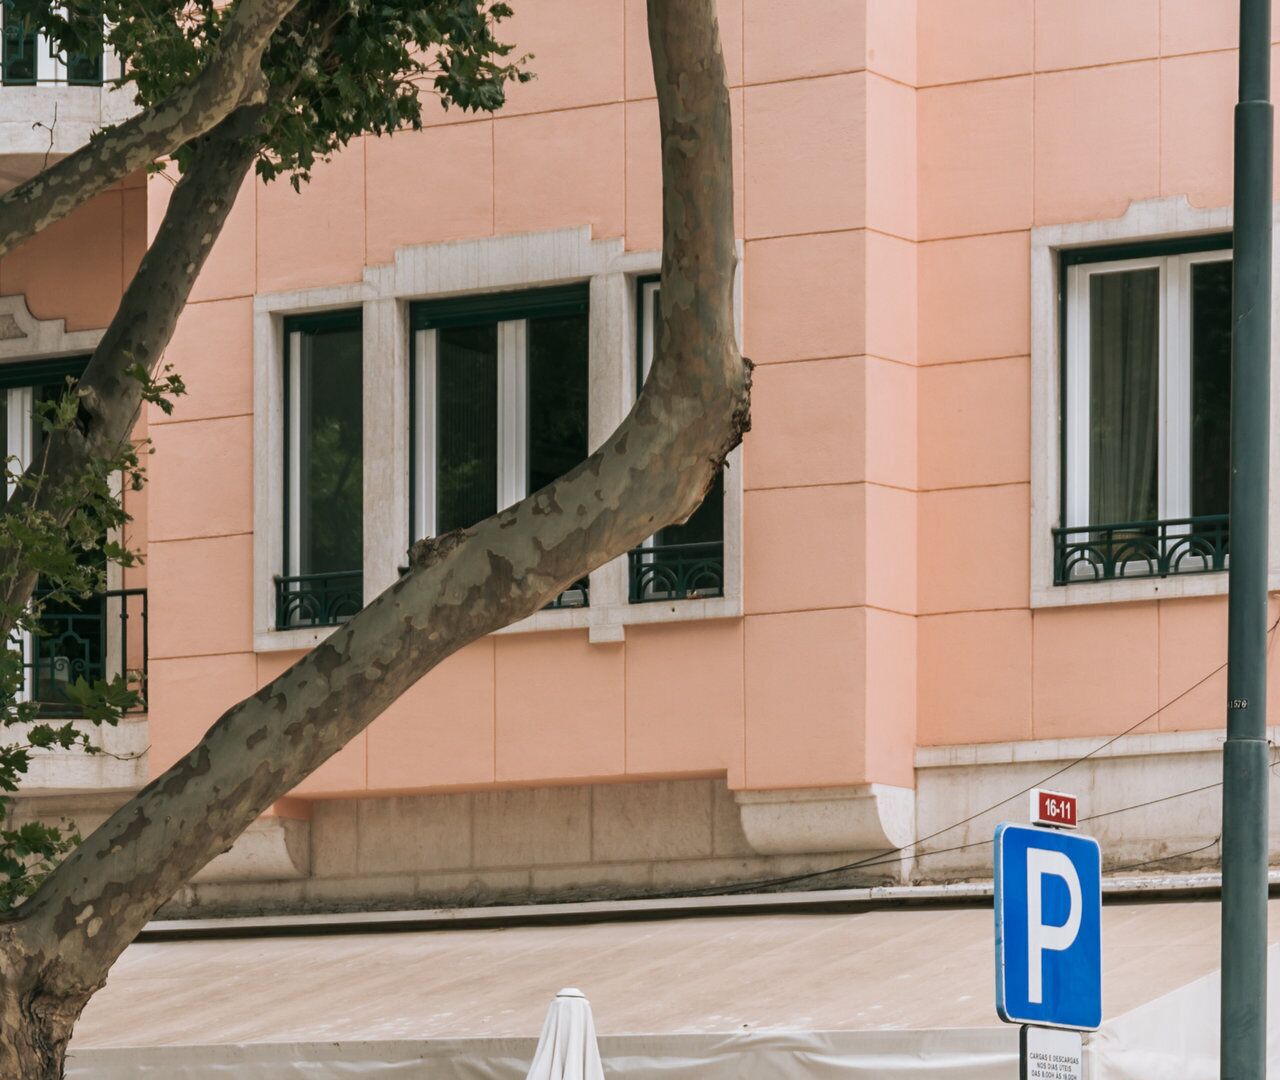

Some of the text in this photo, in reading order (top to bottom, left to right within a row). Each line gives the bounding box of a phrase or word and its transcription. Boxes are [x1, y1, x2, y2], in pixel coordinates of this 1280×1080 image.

[1044, 798, 1071, 820] 16-11
[1026, 847, 1083, 1004] P
[1029, 1052, 1048, 1061] CARGAS
[1052, 1055, 1080, 1065] DESCARGAS
[1037, 1062, 1047, 1070] NOS
[1047, 1063, 1058, 1071] DIAS
